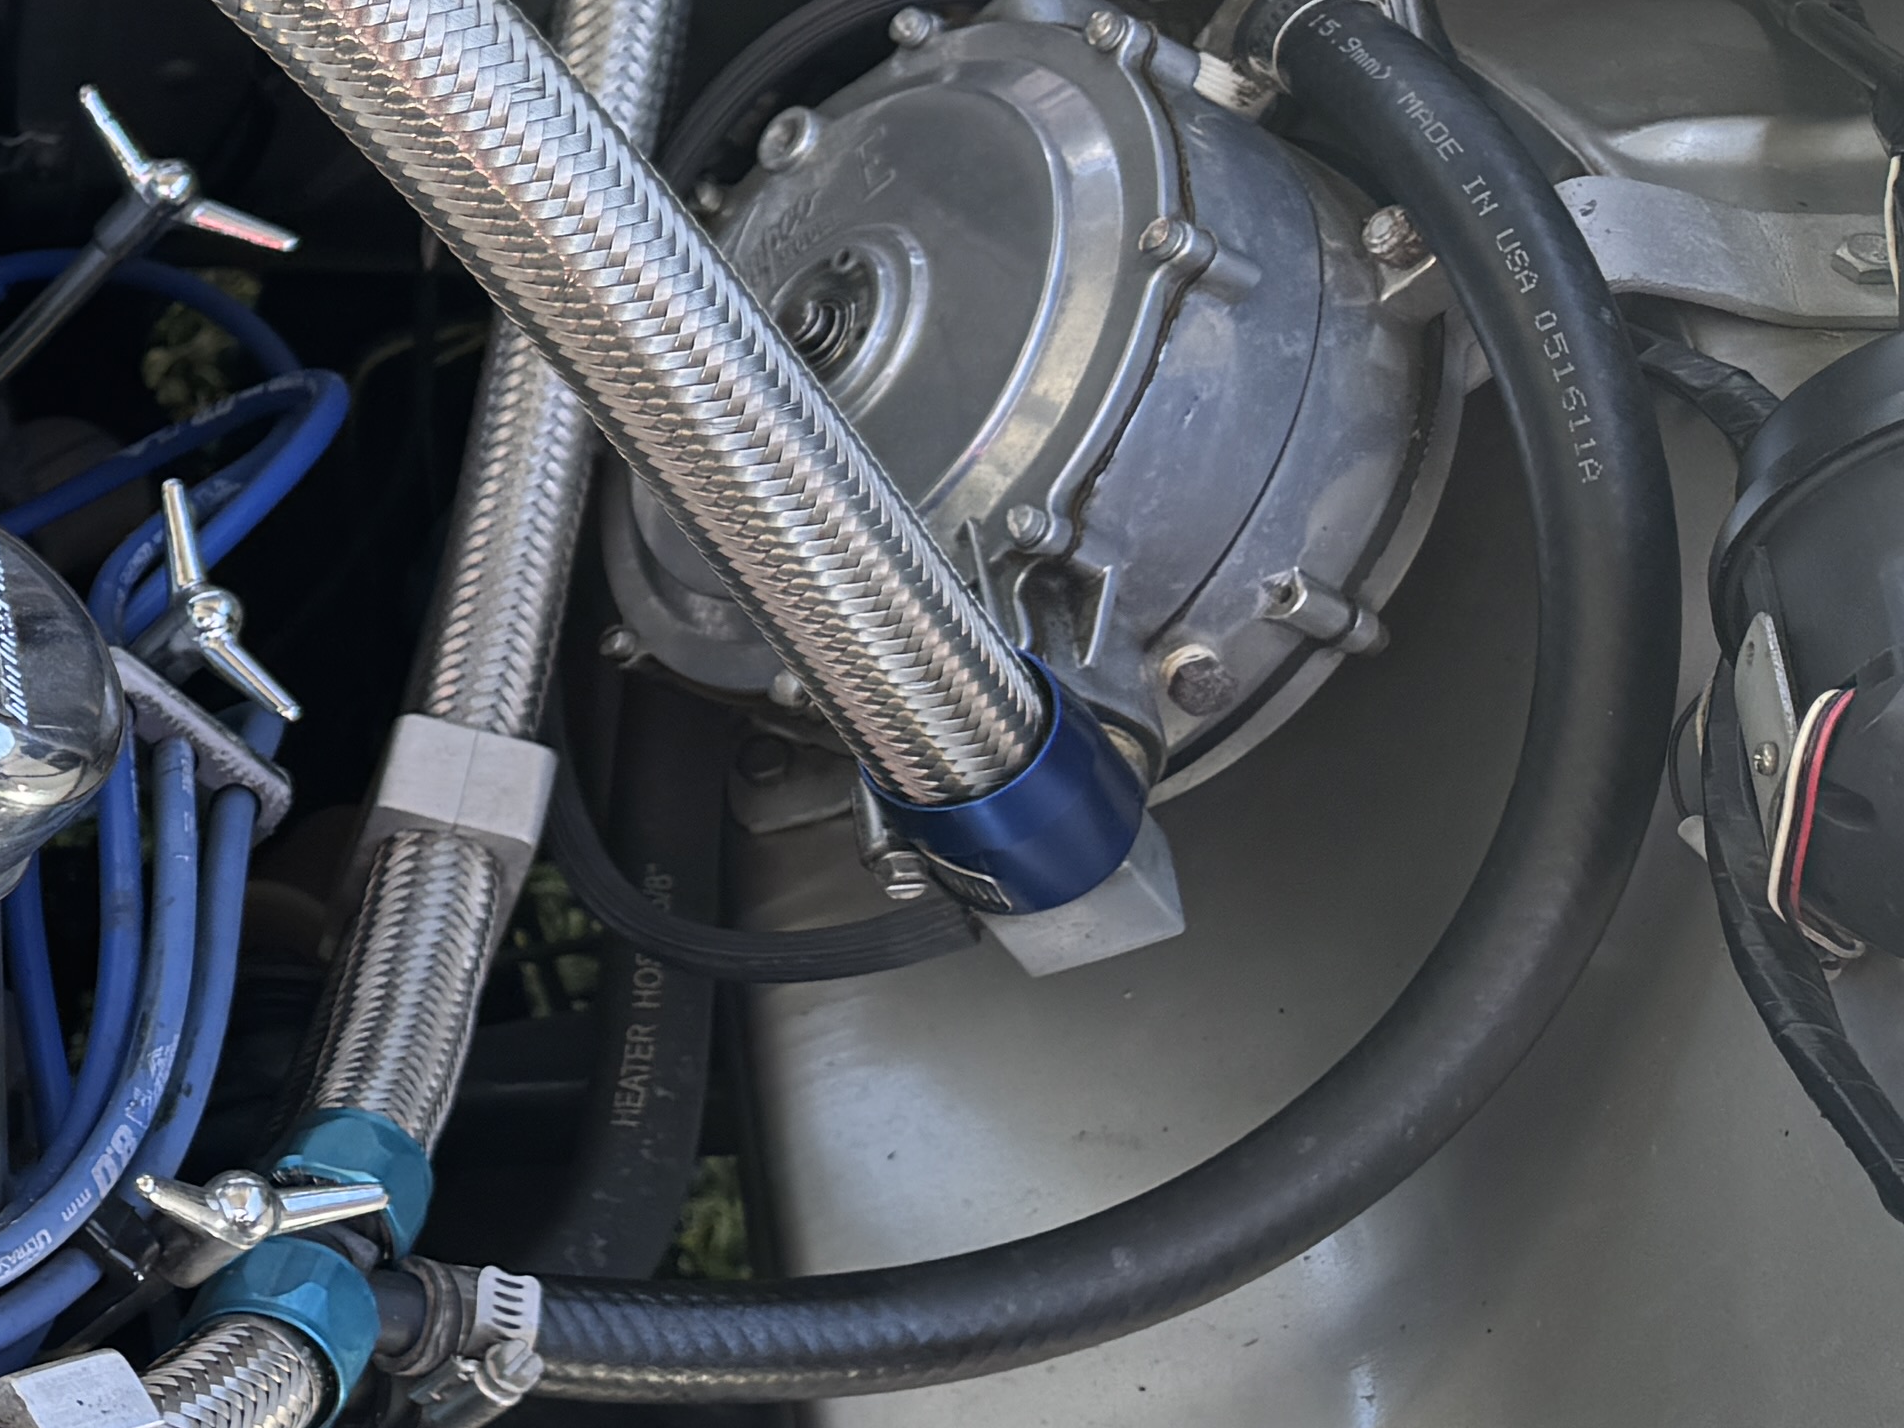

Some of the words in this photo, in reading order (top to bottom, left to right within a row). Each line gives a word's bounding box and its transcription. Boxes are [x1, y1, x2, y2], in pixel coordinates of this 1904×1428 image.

[1397, 91, 1464, 162] MADE
[1462, 174, 1499, 218] IN
[1496, 227, 1539, 294] USA
[1534, 309, 1604, 483] 051611A
[610, 1023, 658, 1129] HEATER
